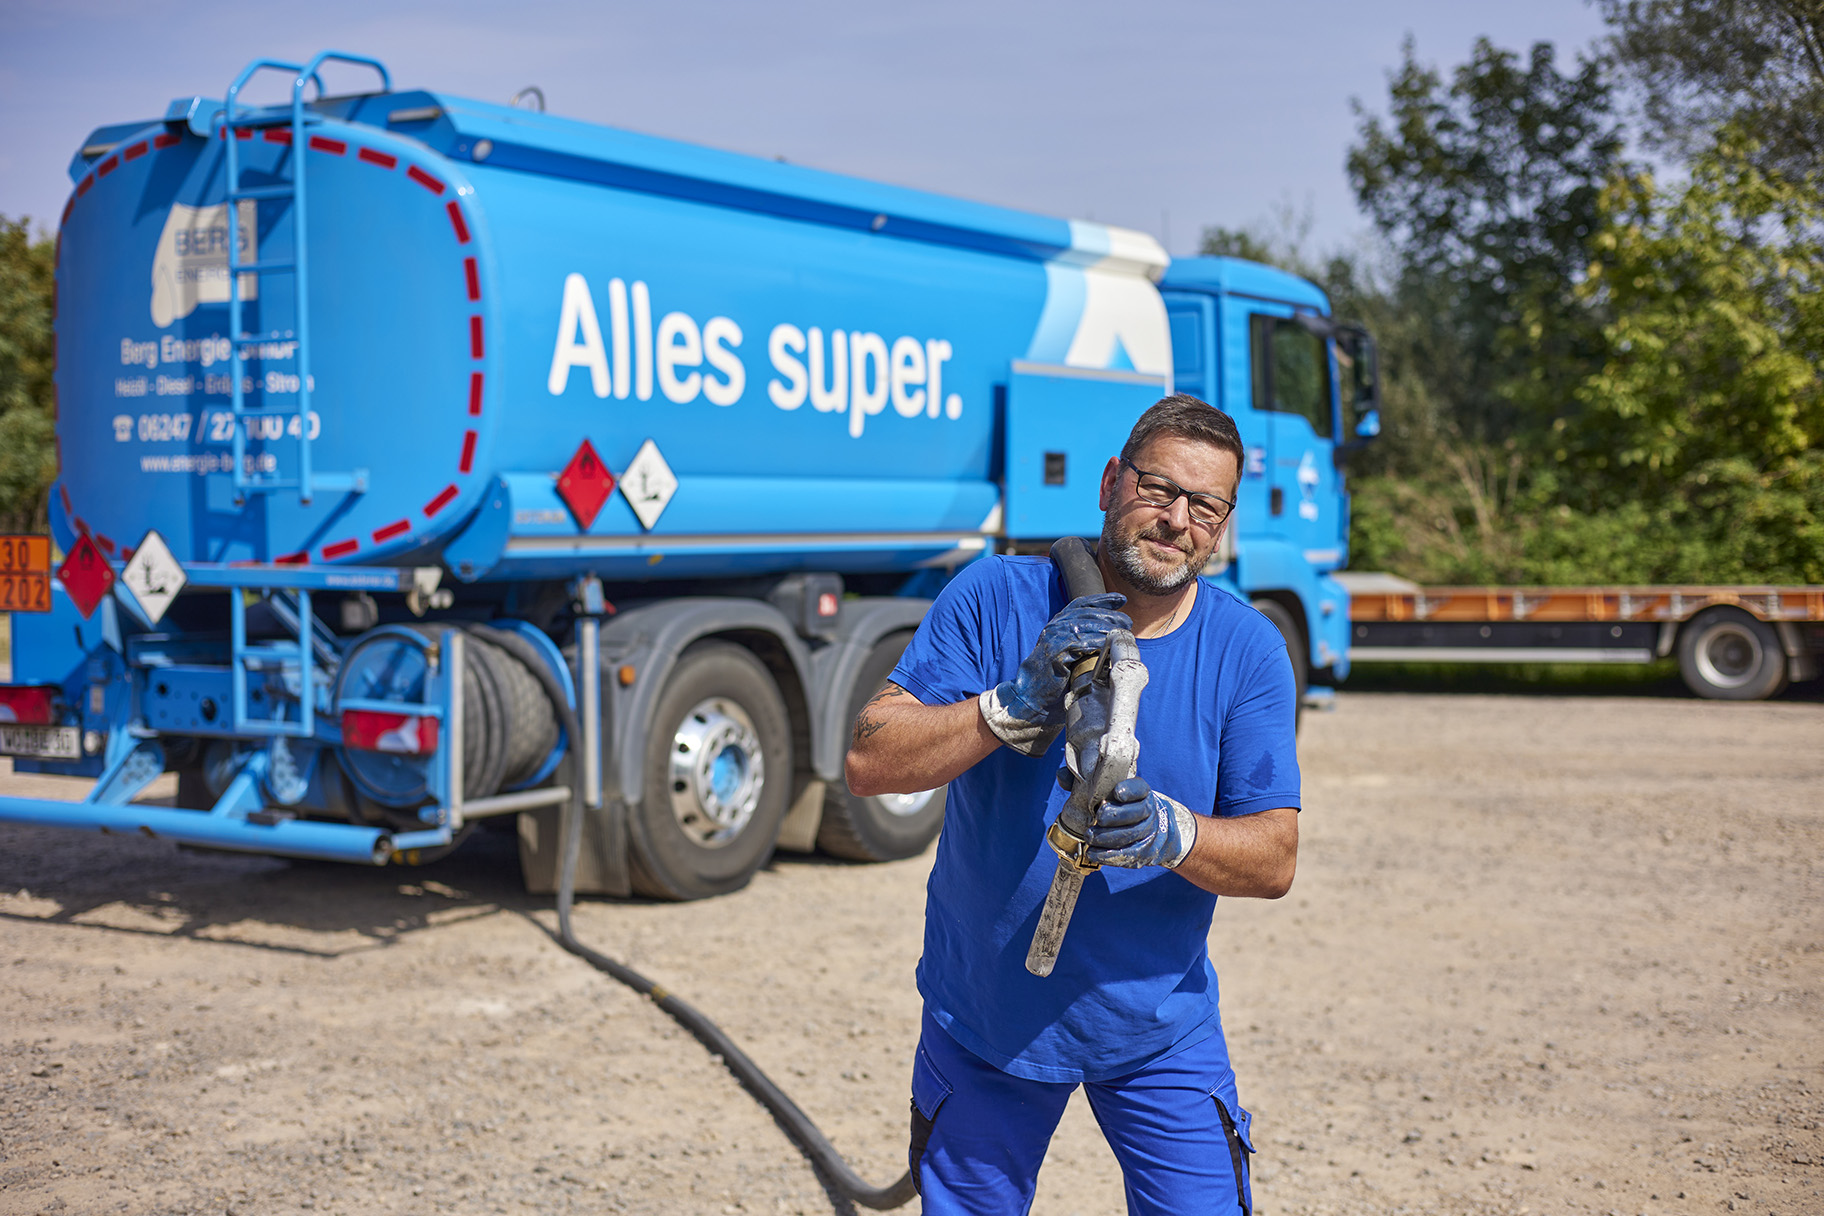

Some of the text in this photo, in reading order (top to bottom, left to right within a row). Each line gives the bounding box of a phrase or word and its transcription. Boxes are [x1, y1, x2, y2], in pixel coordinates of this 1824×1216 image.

[121, 337, 158, 369] Berg
[160, 334, 232, 367] Energie
[548, 272, 962, 438] Alles super.
[3, 541, 29, 568] 30
